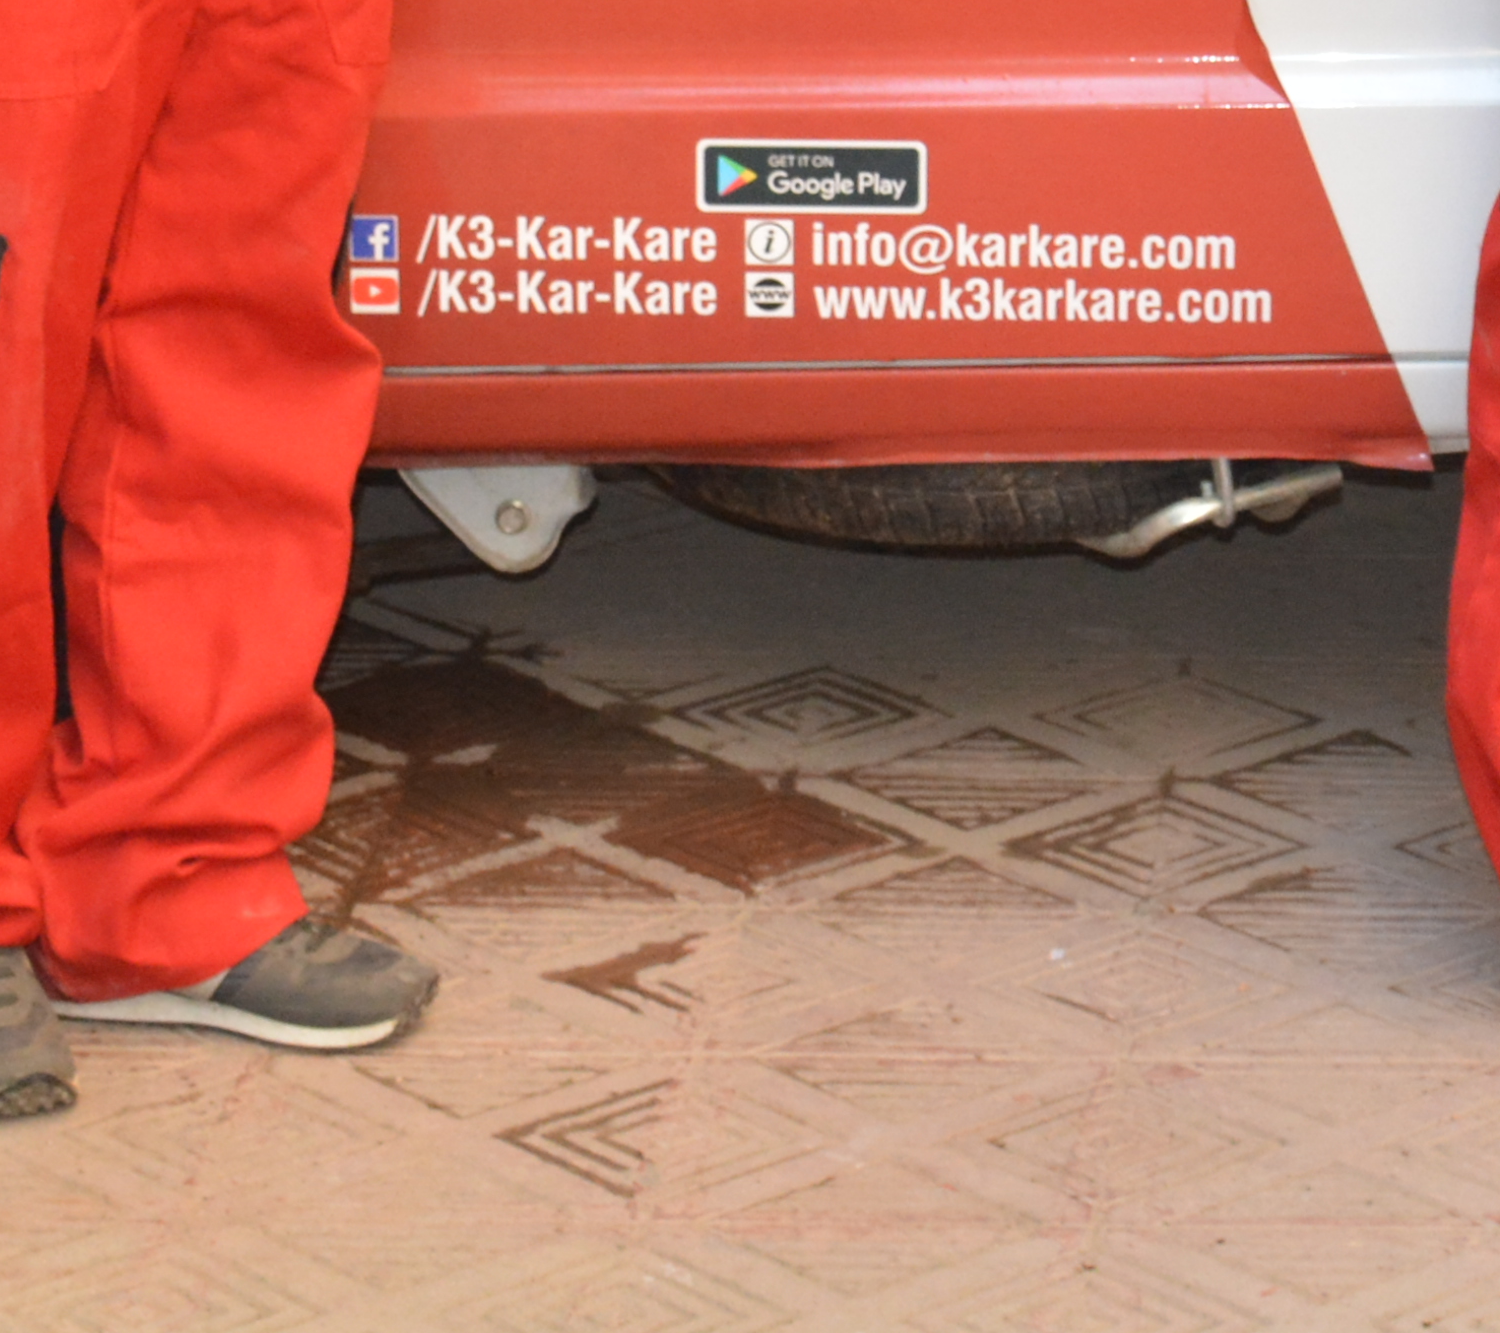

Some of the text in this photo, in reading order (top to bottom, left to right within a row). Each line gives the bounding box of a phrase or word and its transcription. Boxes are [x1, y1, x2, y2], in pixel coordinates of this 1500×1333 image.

[767, 154, 835, 168] GET IT ON
[767, 170, 907, 201] Google Play
[415, 213, 718, 264] /K3-Kar-Kare
[811, 221, 1237, 275] info@karkare.com
[416, 267, 718, 318] /K3-Kar-Kare
[813, 276, 1273, 324] www.k3karkare.com
